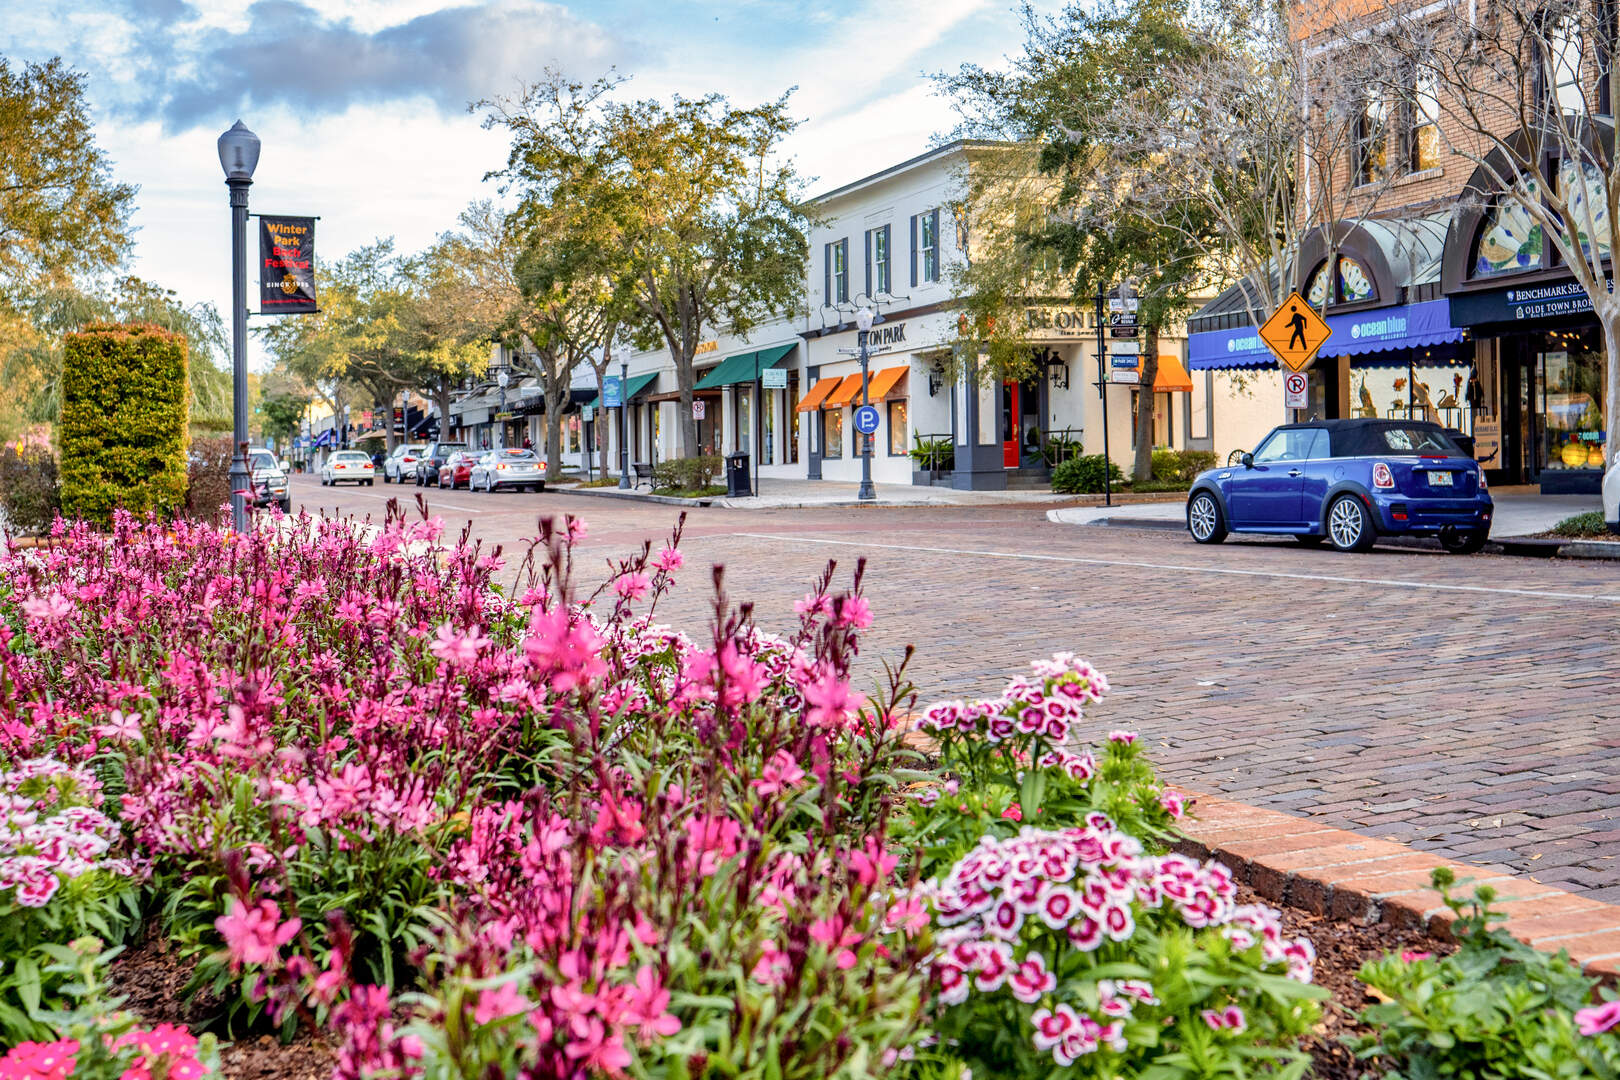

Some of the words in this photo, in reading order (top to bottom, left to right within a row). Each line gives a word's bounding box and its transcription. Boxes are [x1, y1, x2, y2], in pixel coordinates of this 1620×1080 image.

[267, 223, 308, 235] Winter
[274, 235, 301, 246] Park
[273, 246, 301, 258] Bach
[264, 258, 309, 270] Festival
[1516, 285, 1568, 301] BENCHMARK
[1525, 304, 1545, 314] OLDE
[1546, 301, 1570, 312] TOWN
[1055, 311, 1084, 329] ON
[1361, 320, 1387, 338] ocean
[1387, 315, 1407, 334] blue
[870, 329, 883, 346] ON
[884, 322, 906, 345] PARK
[1235, 336, 1257, 352] ocean
[862, 411, 874, 429] P
